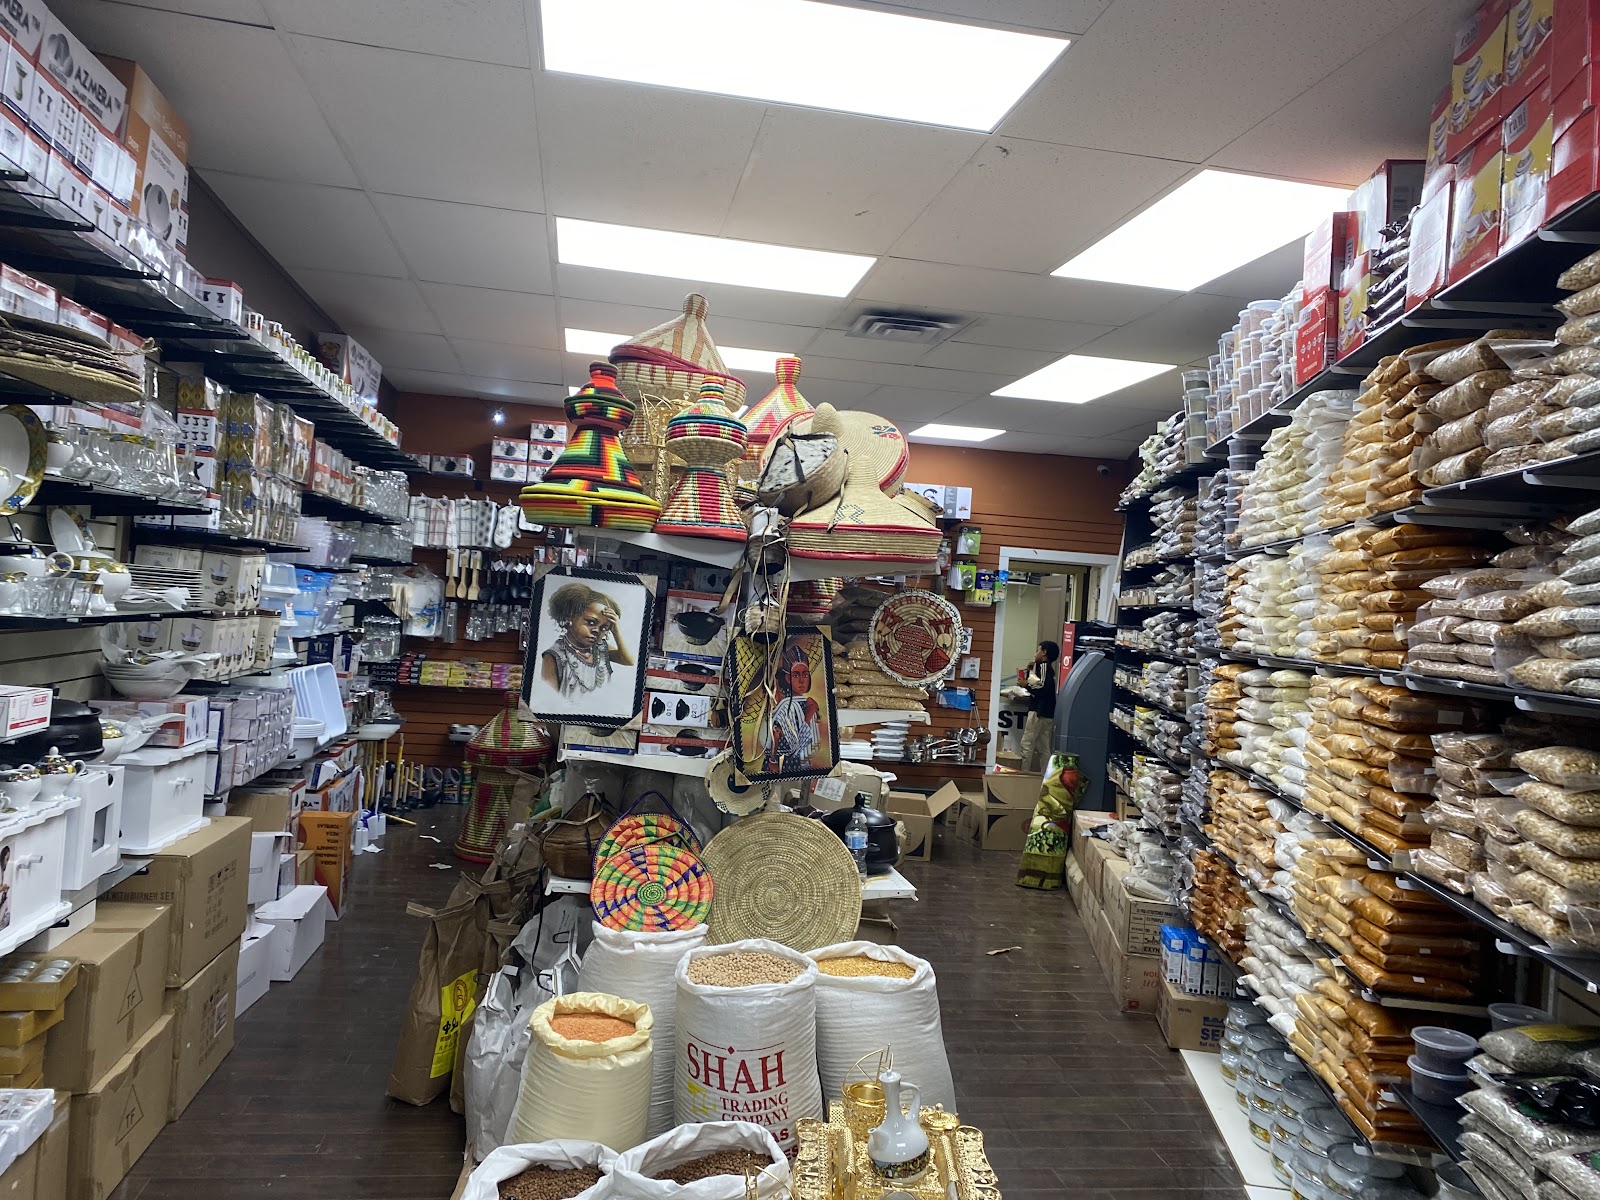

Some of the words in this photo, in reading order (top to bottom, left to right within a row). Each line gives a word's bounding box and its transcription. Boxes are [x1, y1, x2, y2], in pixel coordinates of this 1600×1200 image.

[160, 891, 175, 901] SET
[686, 1042, 787, 1094] SHAH
[719, 1090, 789, 1113] TRADING
[721, 1105, 790, 1127] COMPANY
